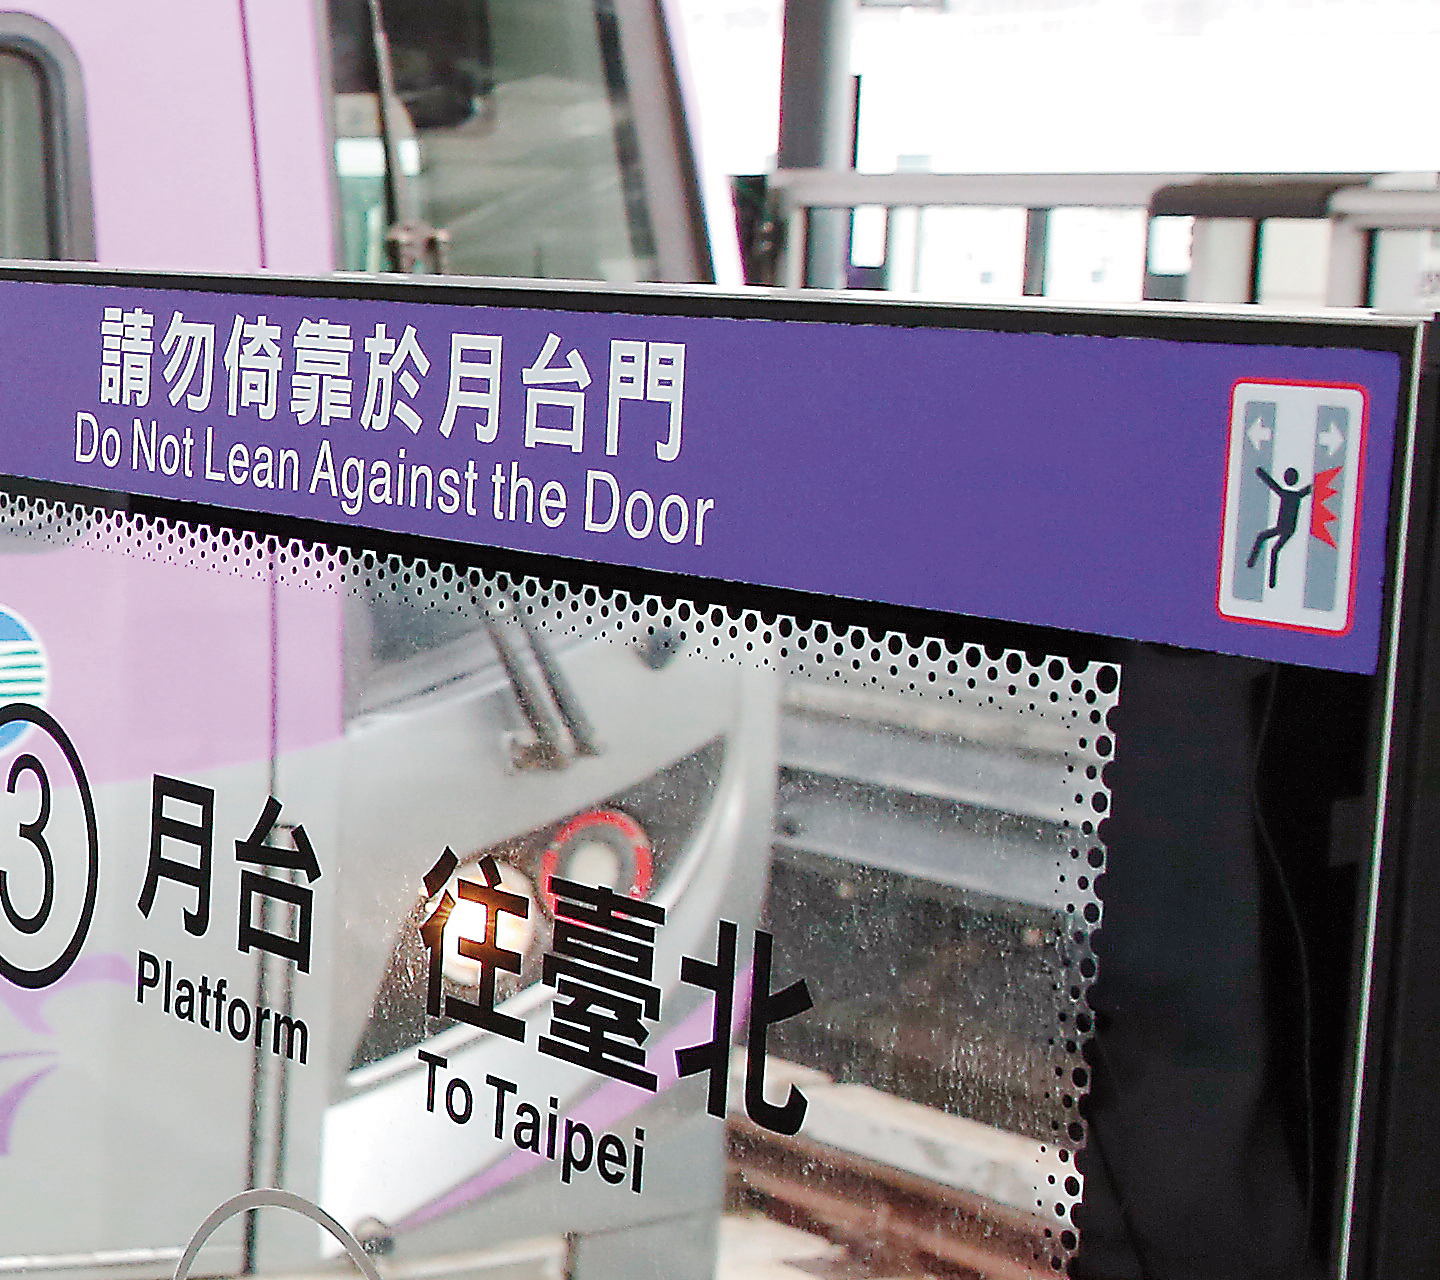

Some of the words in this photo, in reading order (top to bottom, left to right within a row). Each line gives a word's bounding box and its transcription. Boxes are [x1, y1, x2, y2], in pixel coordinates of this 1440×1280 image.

[75, 411, 121, 469] Do
[132, 418, 195, 478] Not
[205, 426, 299, 492] Lean
[309, 439, 479, 517] Against
[491, 462, 567, 528] the
[584, 469, 716, 546] Door
[100, 307, 686, 462] 請勿倚靠於月台門
[138, 774, 323, 974] 月台
[421, 845, 816, 1136] 往臺北
[137, 950, 309, 1065] Platform
[417, 1049, 473, 1125] To
[485, 1073, 645, 1194] Taipei
